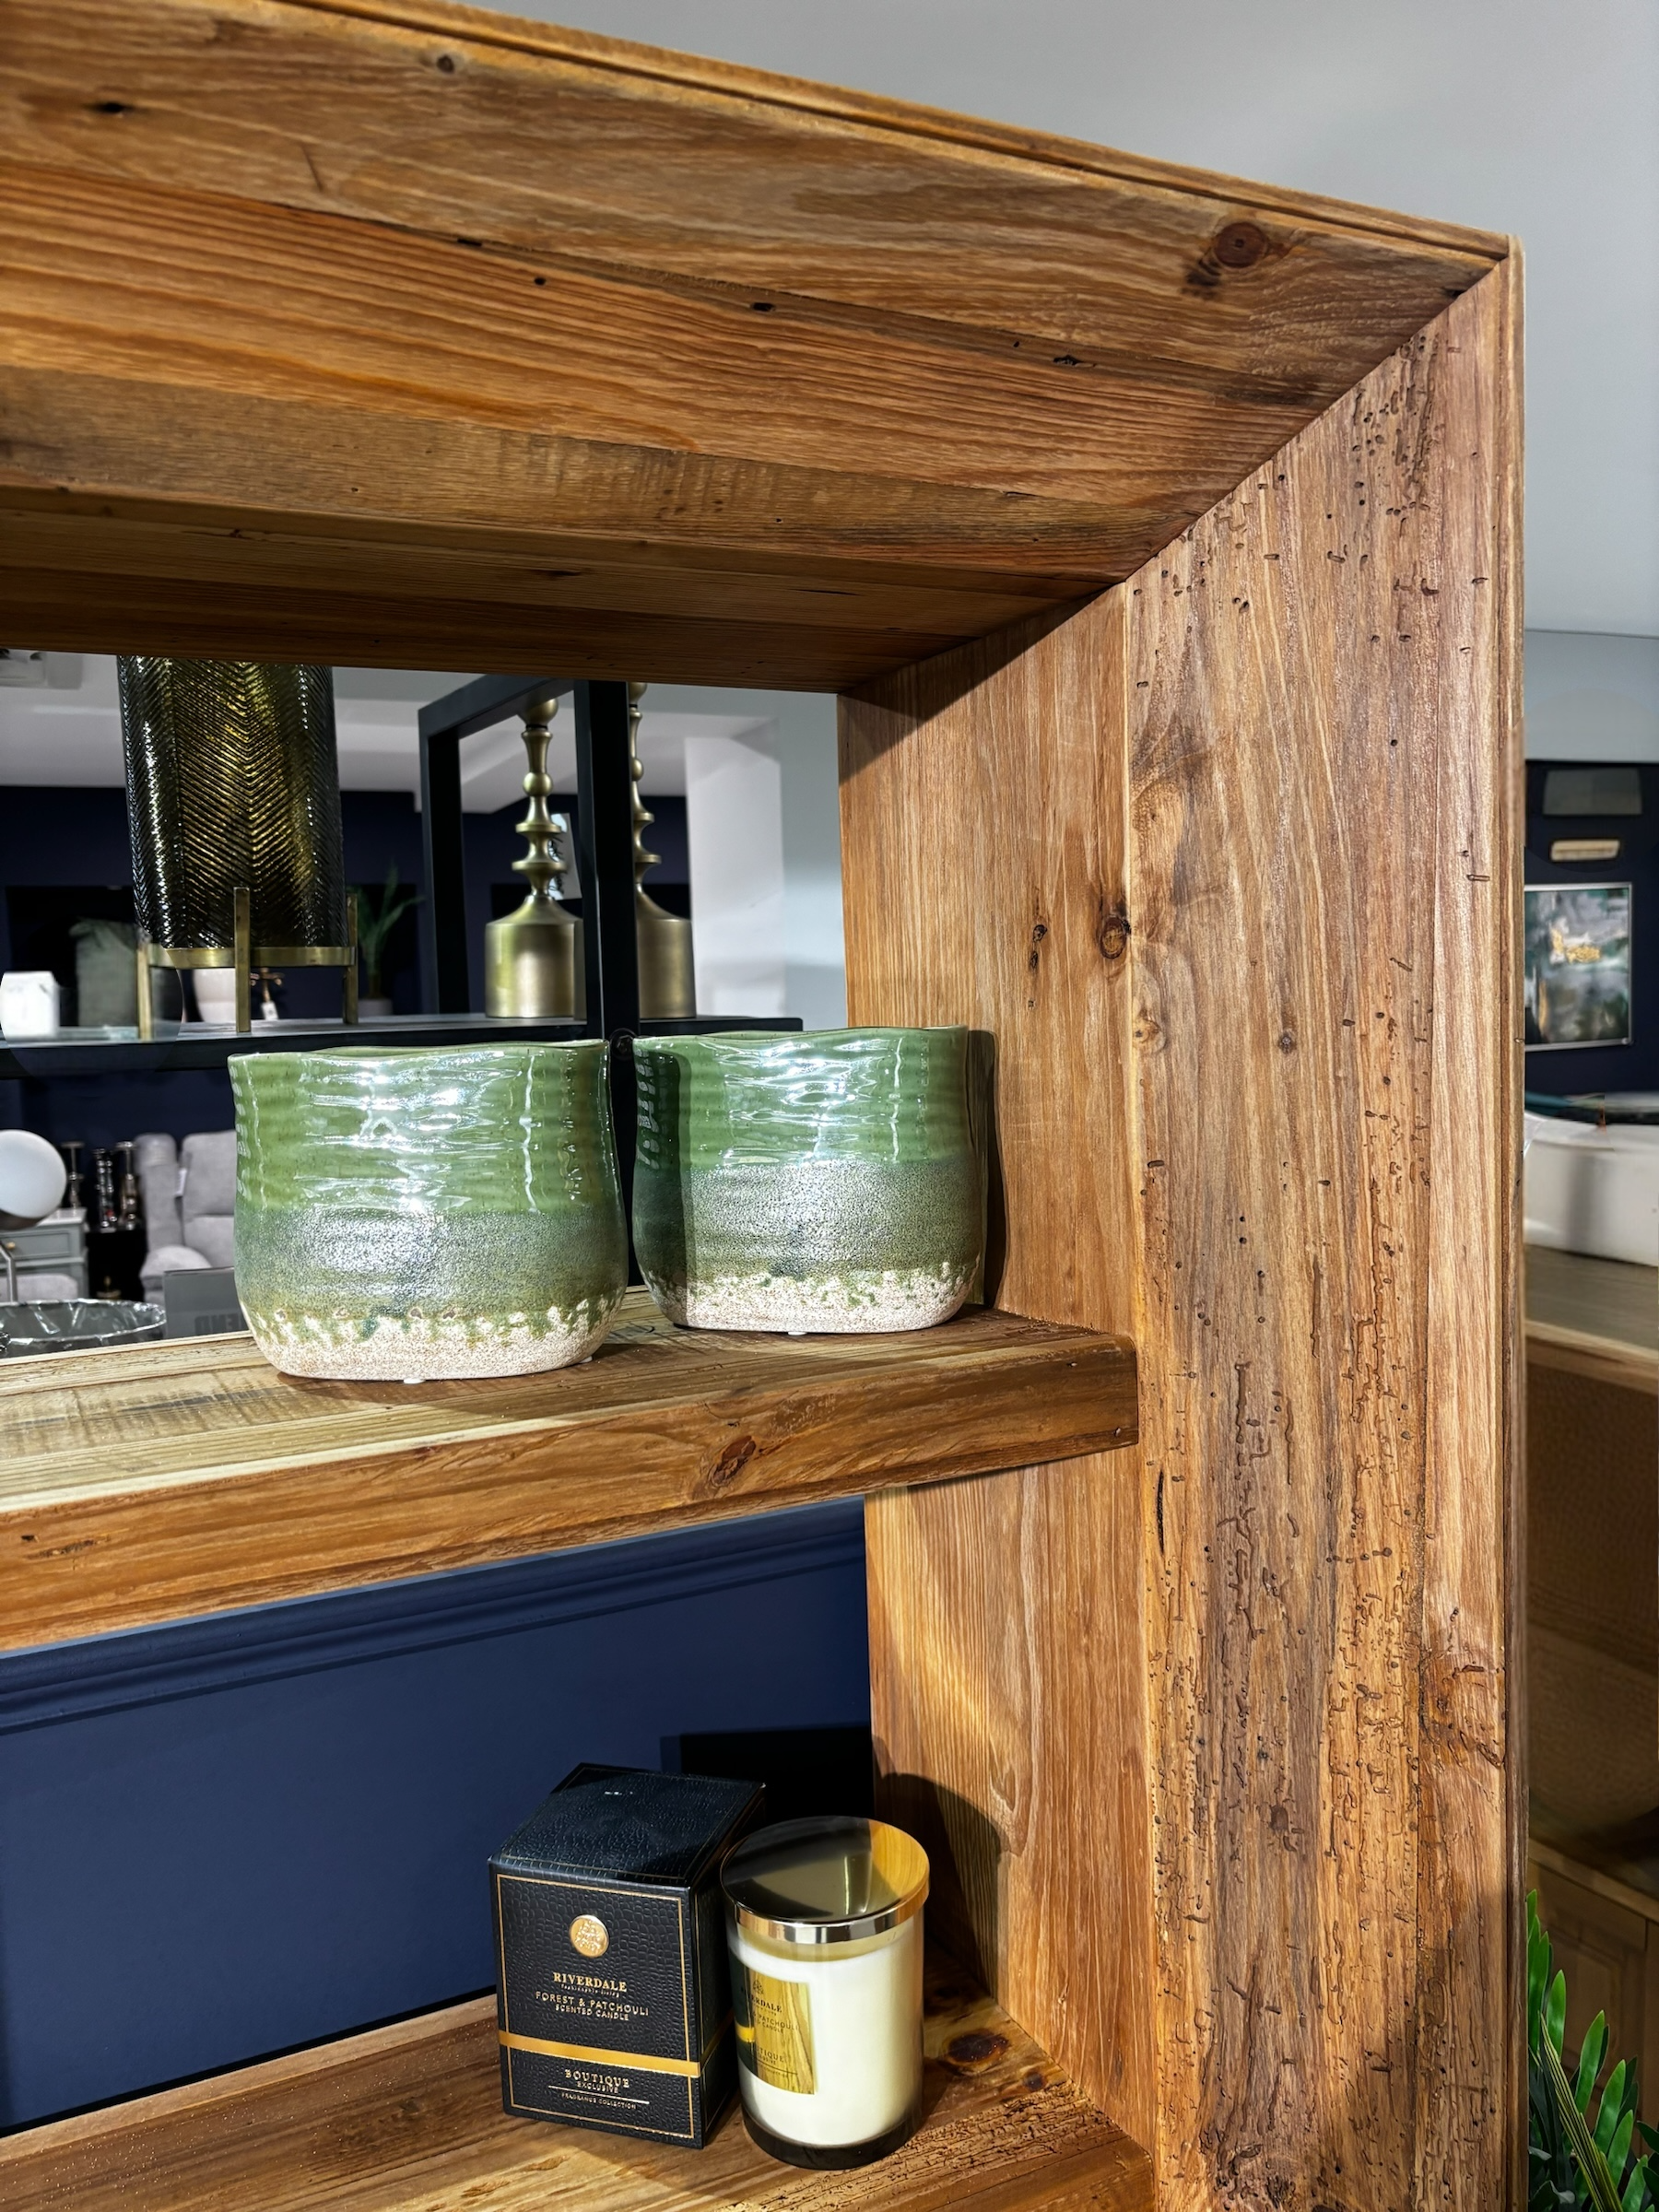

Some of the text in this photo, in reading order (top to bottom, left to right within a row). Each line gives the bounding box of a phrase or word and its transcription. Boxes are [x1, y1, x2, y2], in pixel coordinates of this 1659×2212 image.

[553, 1971, 628, 1993] RIVERDALE
[535, 1991, 649, 2017] FOREST & PATCHOULI
[555, 2004, 629, 2021] SCENTED CANDLE
[565, 2069, 630, 2088] BOUTIQUE
[577, 2081, 619, 2094] EXCLUSIVE
